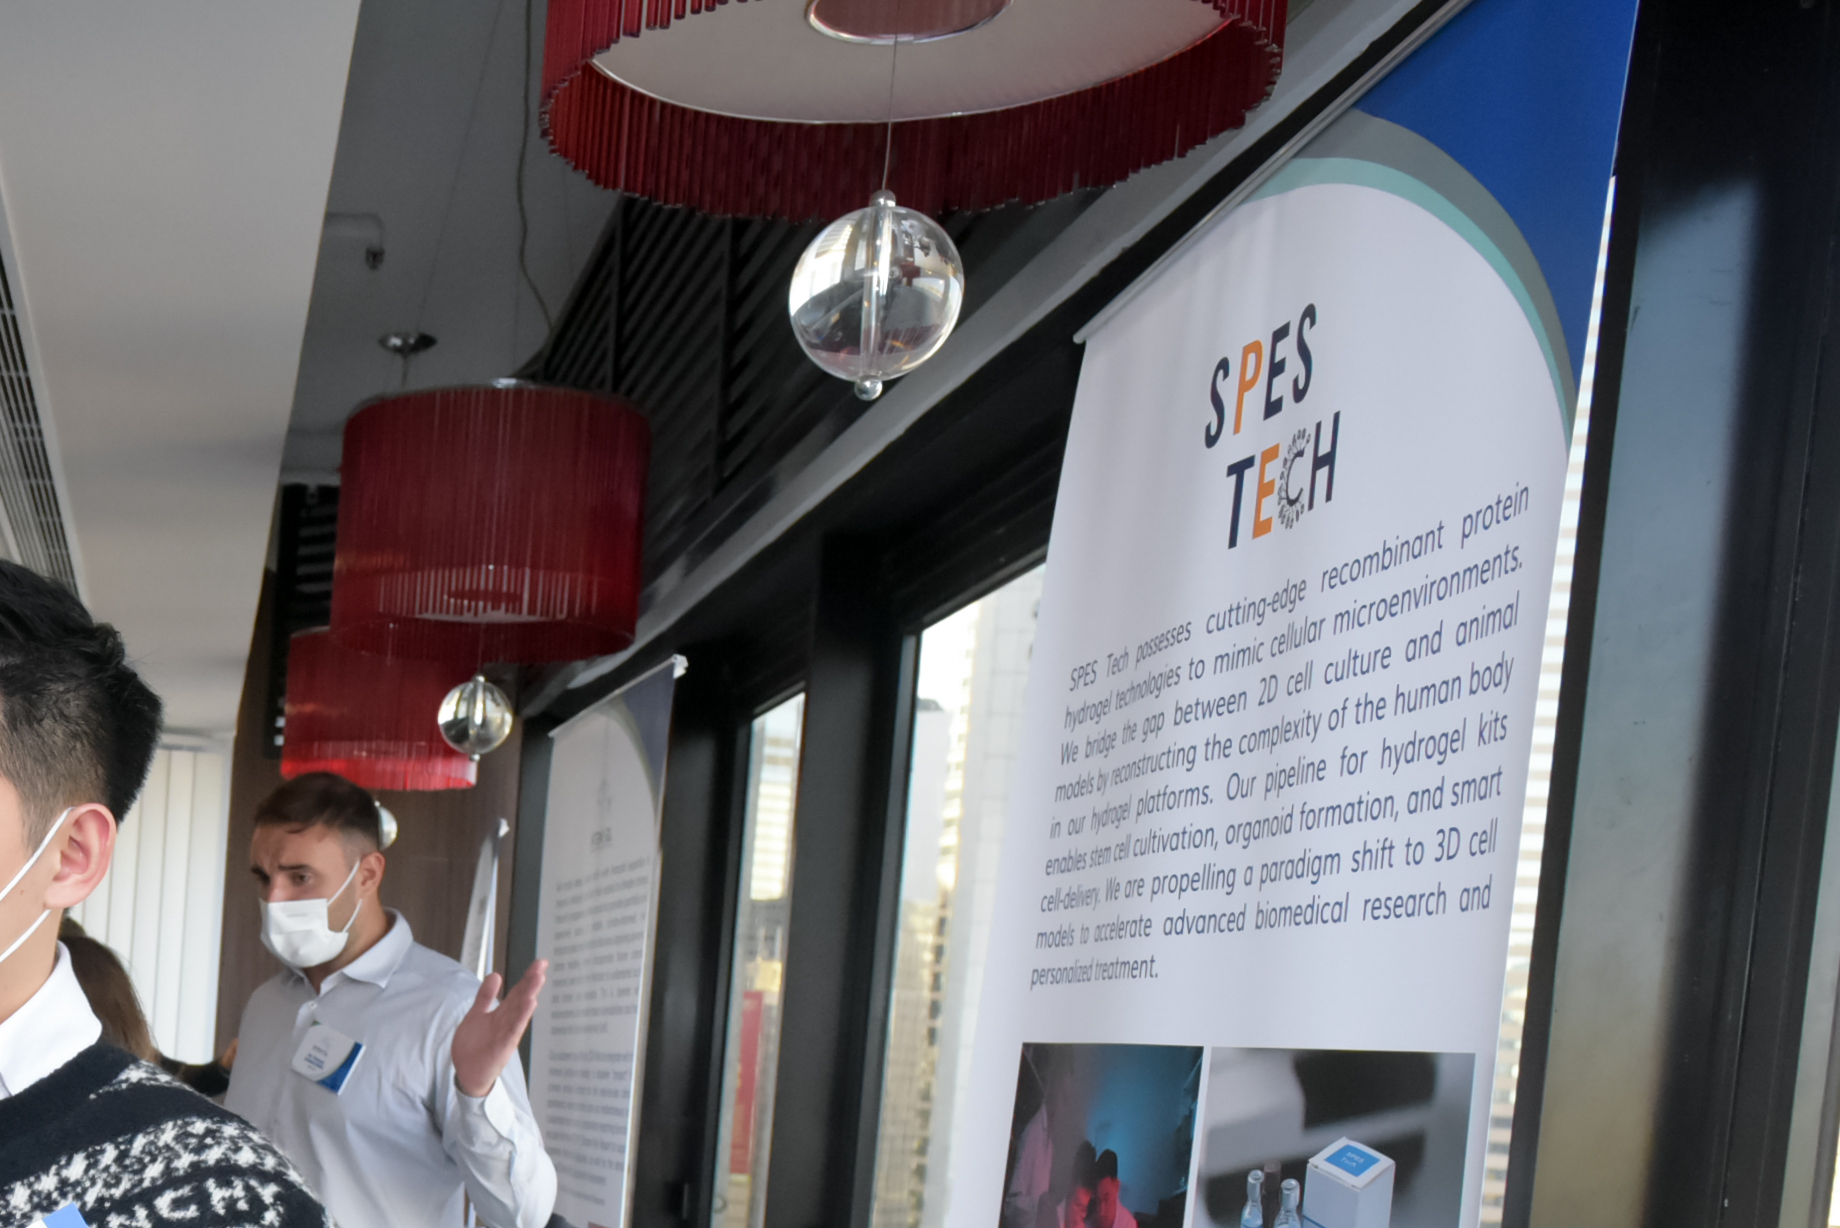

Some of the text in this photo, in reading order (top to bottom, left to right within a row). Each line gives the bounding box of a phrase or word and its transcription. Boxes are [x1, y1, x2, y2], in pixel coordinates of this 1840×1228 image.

[1204, 302, 1317, 449] SPES
[1226, 410, 1341, 550] TECH
[1063, 543, 1523, 733] hydrogel technologies to mimic cellular microenvironments.
[1069, 481, 1529, 692] SPES Tech possesses cutting-edge recombinant protein
[1055, 650, 1515, 803] models by reconstructing the complexity of the human body
[1061, 590, 1520, 765] We bridge the gap between 2D cell culture and animal
[1045, 765, 1503, 876] enables stem cell cultivation, organoid formation, and smart
[1049, 710, 1508, 840] in our hydrogel platforms. Our pipeline for hydrogel kits
[1036, 873, 1493, 949] models to accelerate advanced biomedical research and
[1040, 817, 1498, 913] cell-delivery. We are propelling a paradigm shift to 3D cell
[1030, 954, 1159, 991] personalized treatment.
